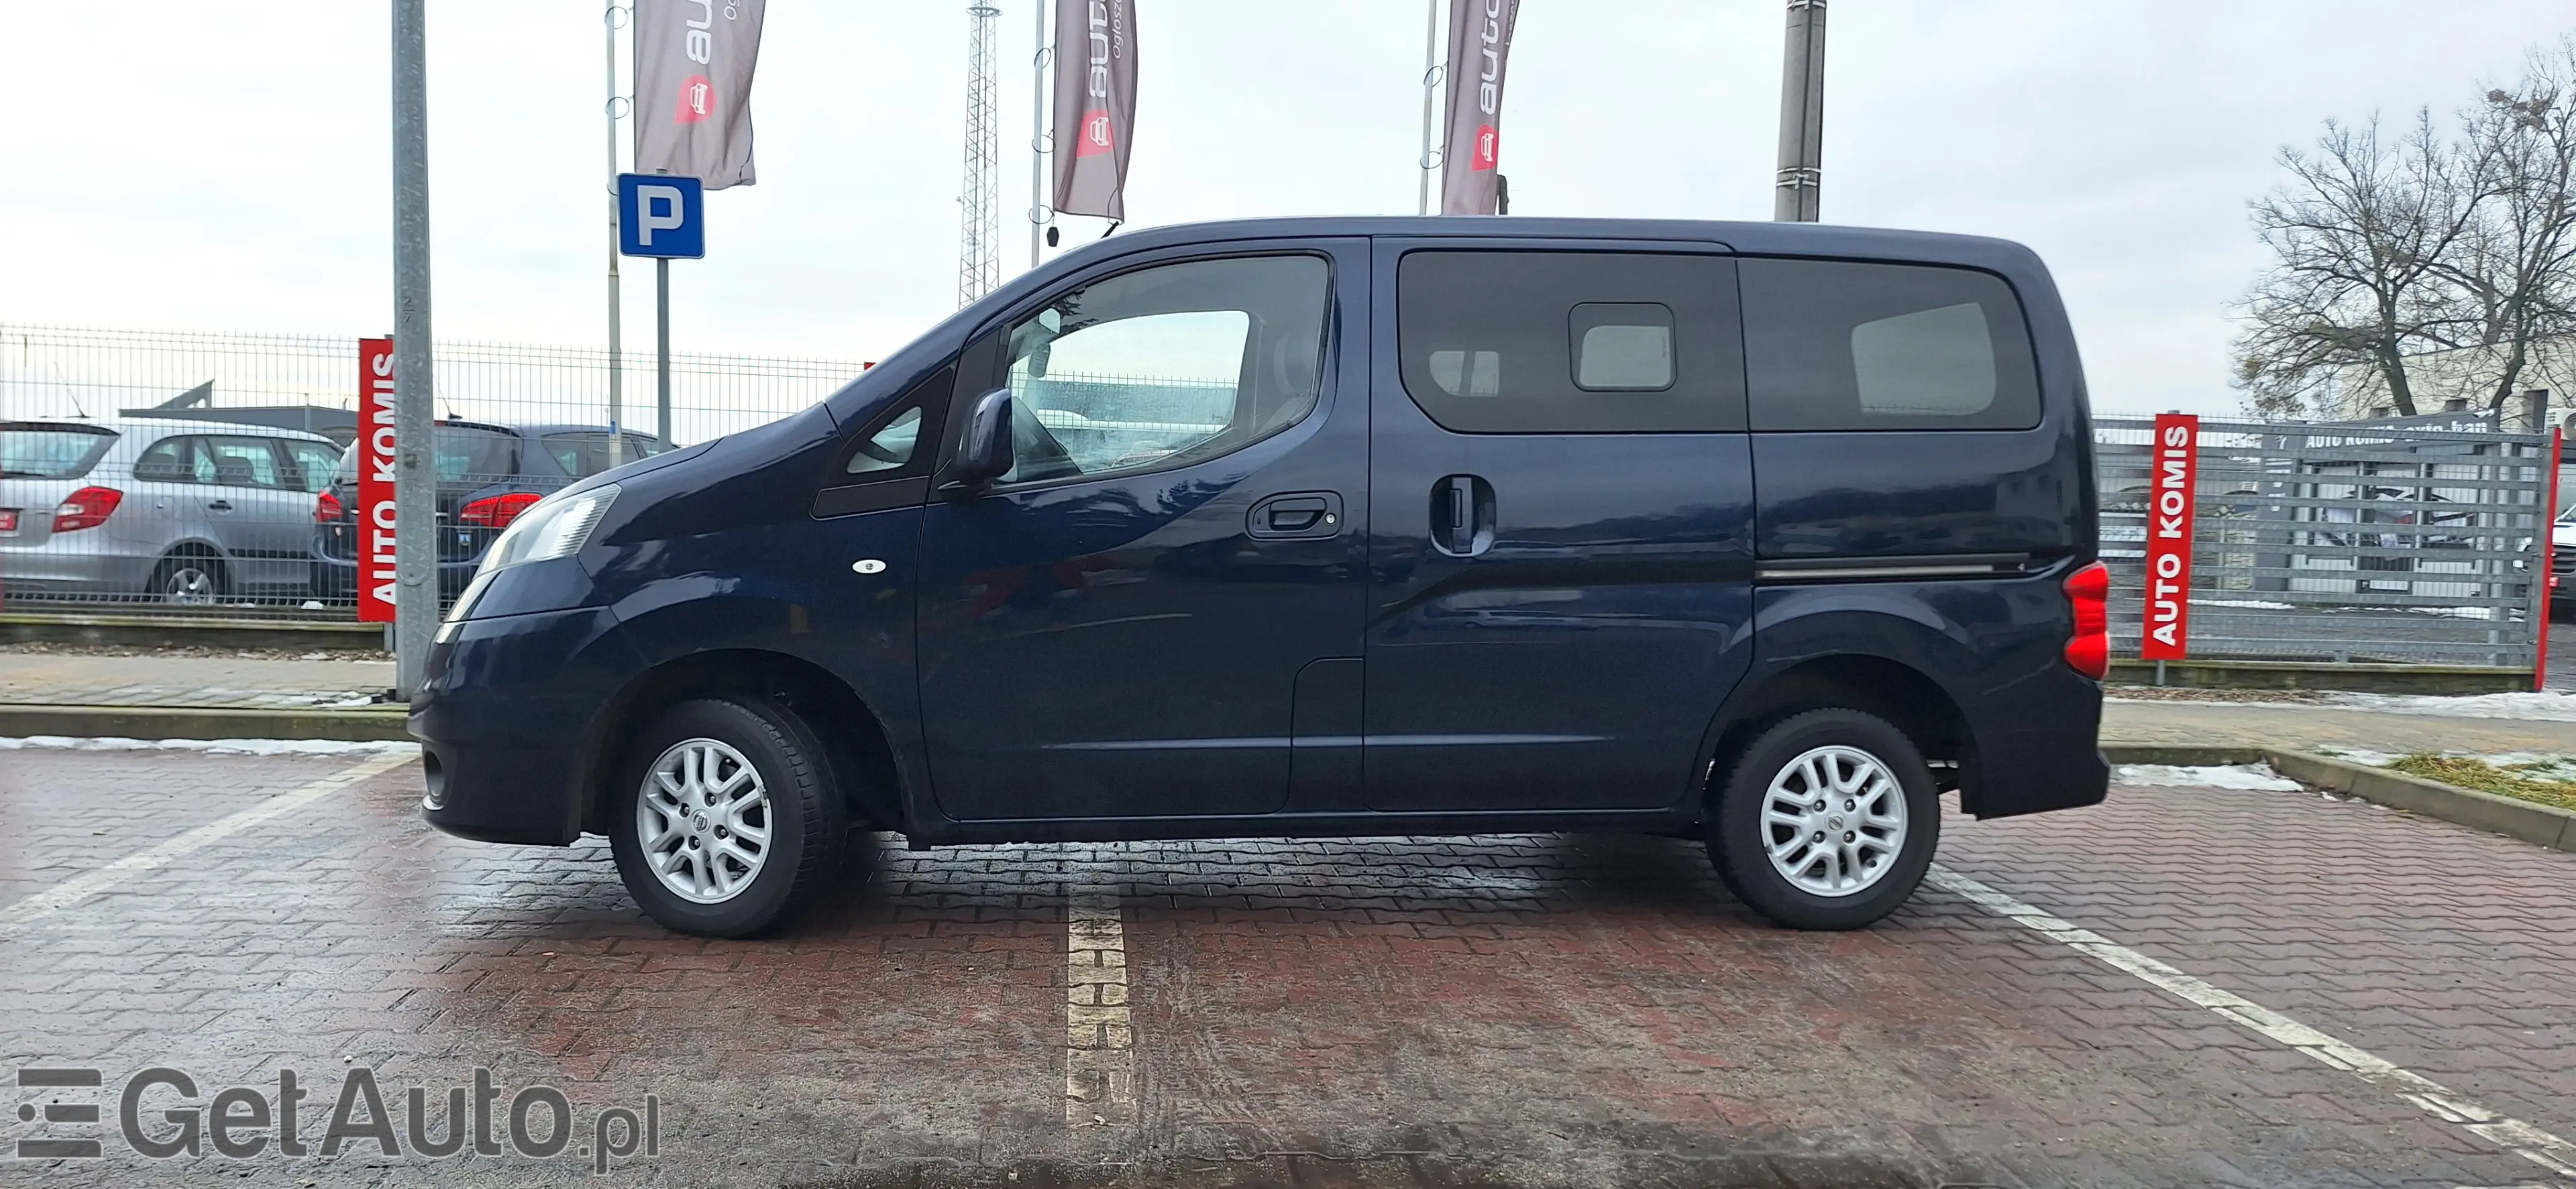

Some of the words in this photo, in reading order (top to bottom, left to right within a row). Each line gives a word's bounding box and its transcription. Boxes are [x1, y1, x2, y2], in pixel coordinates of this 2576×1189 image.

[1088, 0, 1109, 98] aut
[1112, 0, 1124, 59] Ogłosz
[637, 185, 684, 246] P
[372, 351, 396, 483] KOMIS
[2159, 426, 2189, 539] KOMIS
[372, 500, 396, 606] AUTO
[2153, 553, 2182, 646] AUTO
